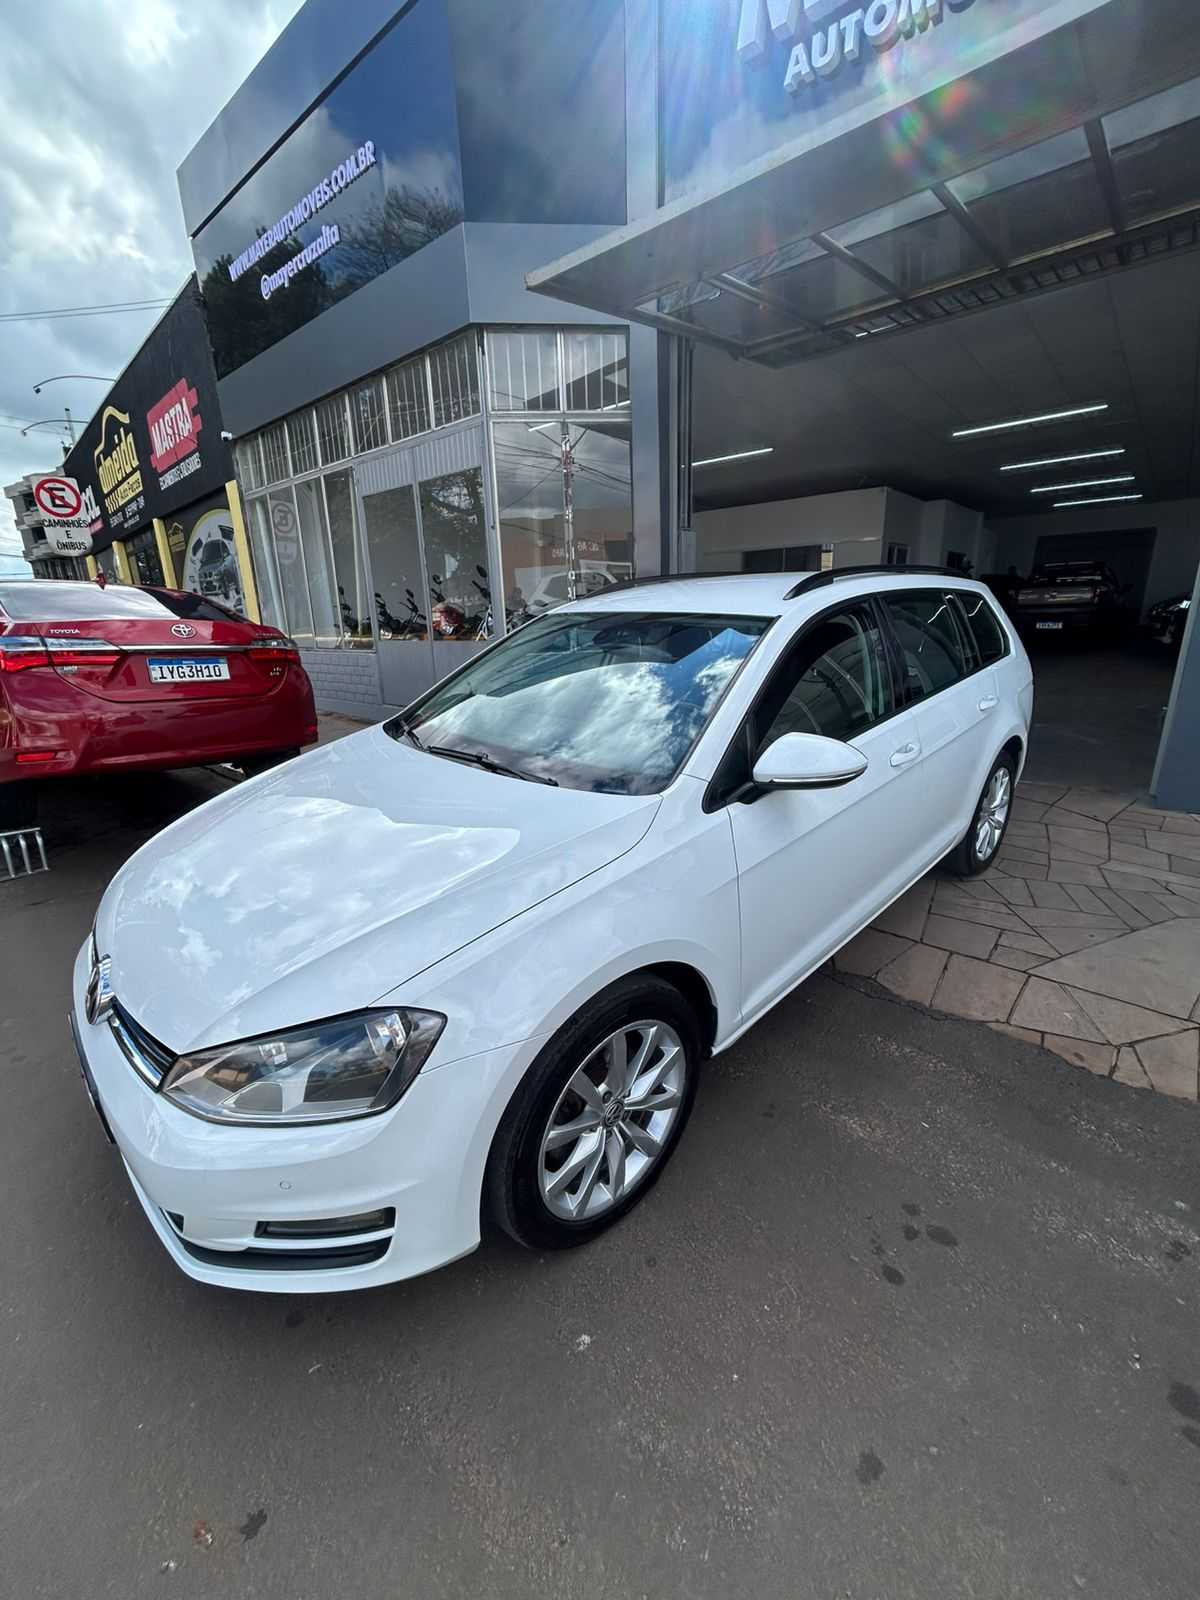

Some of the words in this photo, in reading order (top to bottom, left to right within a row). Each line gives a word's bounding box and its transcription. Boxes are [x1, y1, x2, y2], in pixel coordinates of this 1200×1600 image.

[228, 140, 376, 282] WWW.MAYERAUTOMOVEIS.COM.BR
[151, 397, 193, 458] MASTRA
[65, 530, 73, 539] E
[56, 540, 87, 551] ÔNIBUS
[158, 664, 222, 680] IYG3H10
